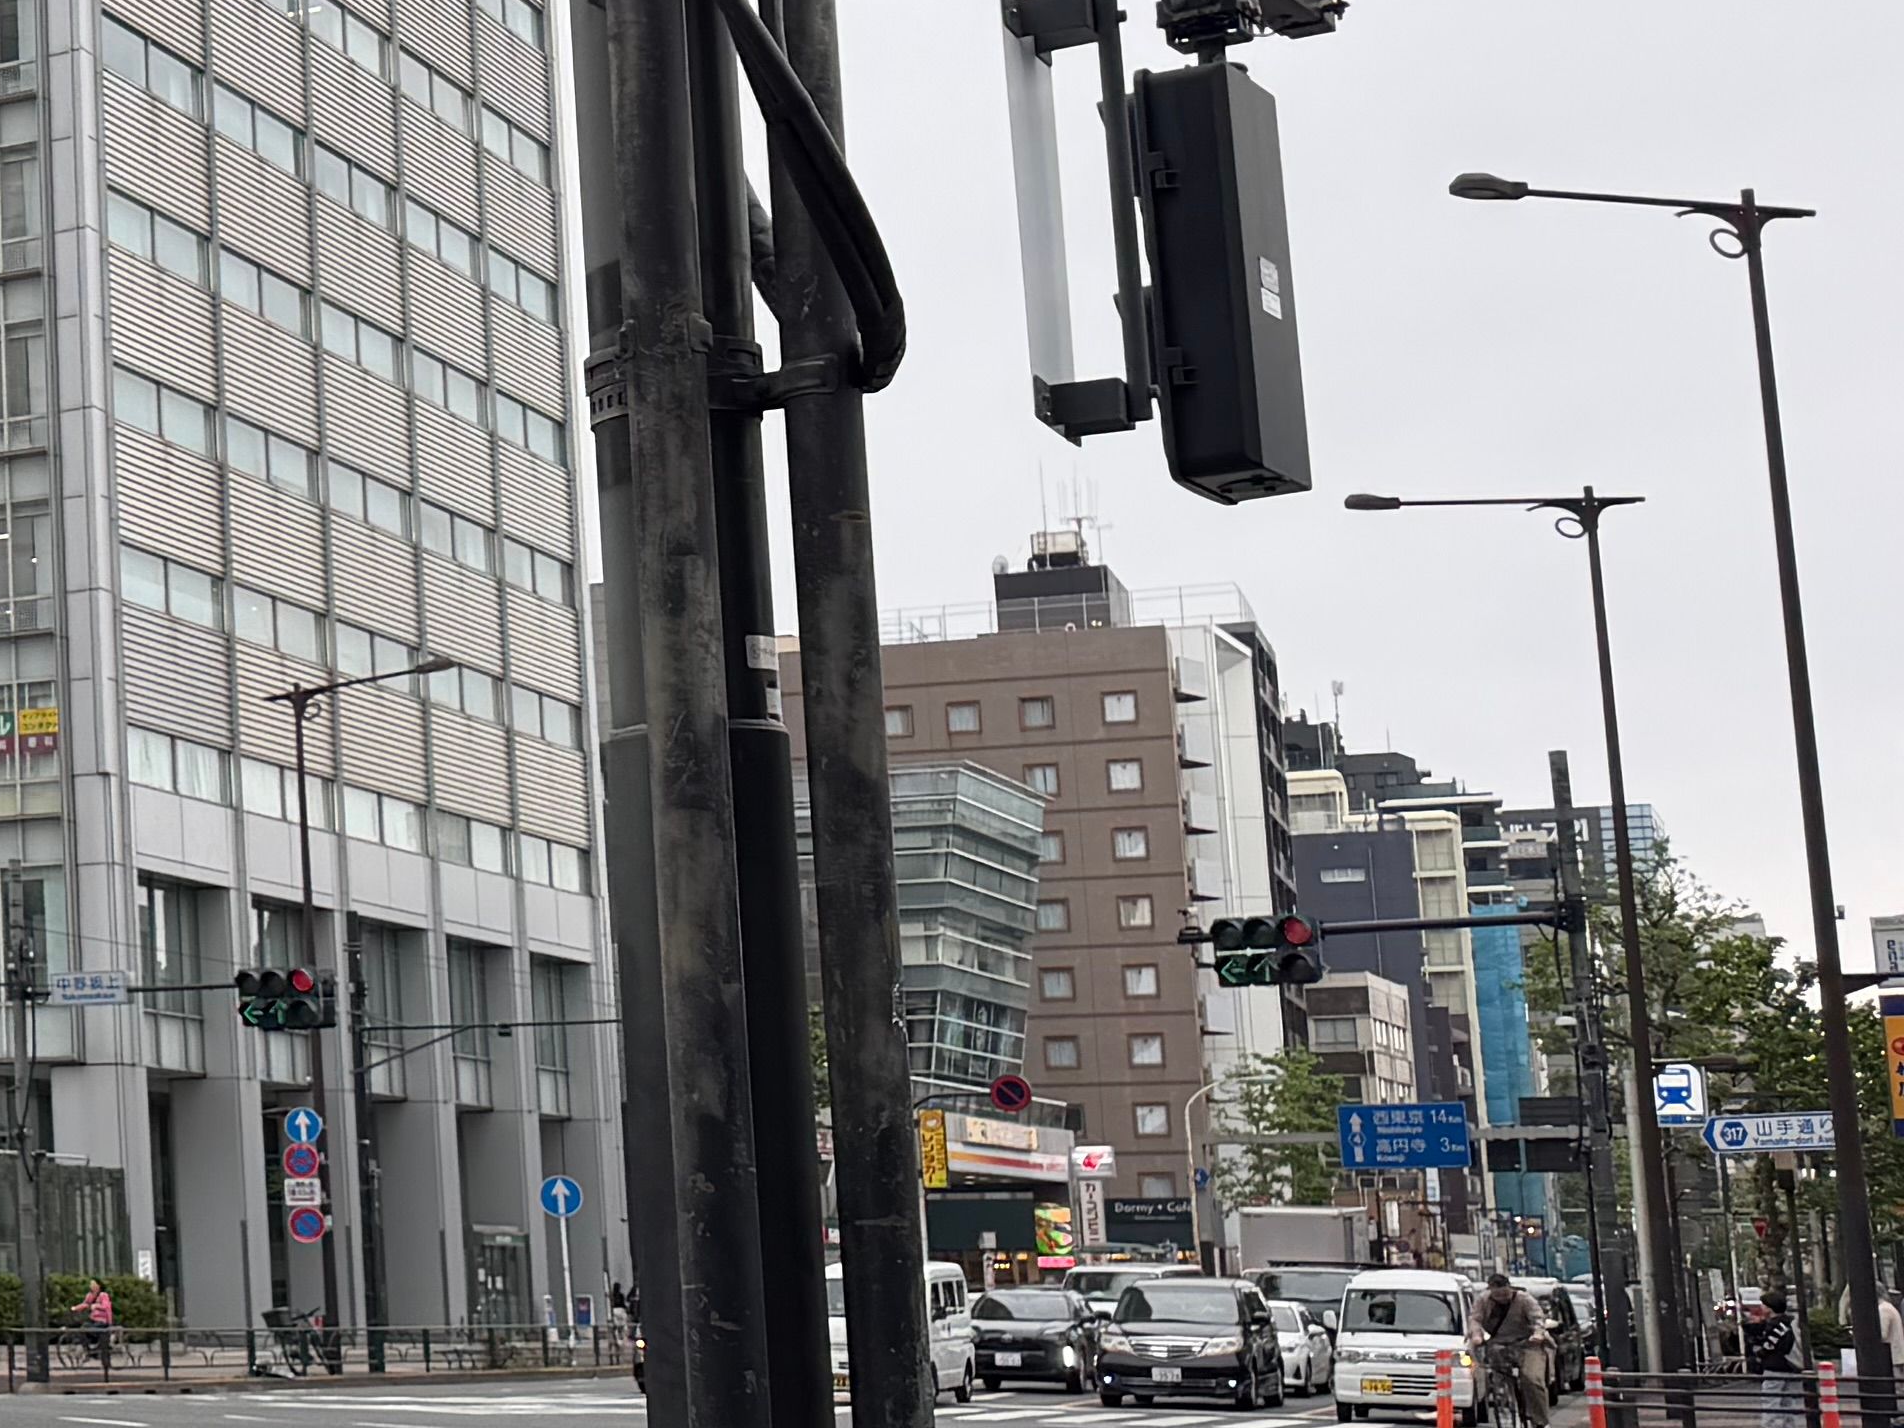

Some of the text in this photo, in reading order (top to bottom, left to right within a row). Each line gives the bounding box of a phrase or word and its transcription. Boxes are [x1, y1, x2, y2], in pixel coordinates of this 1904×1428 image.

[1722, 1126, 1745, 1143] 317
[1756, 1116, 1834, 1136] 山手通り
[1114, 1201, 1154, 1214] Dormy
